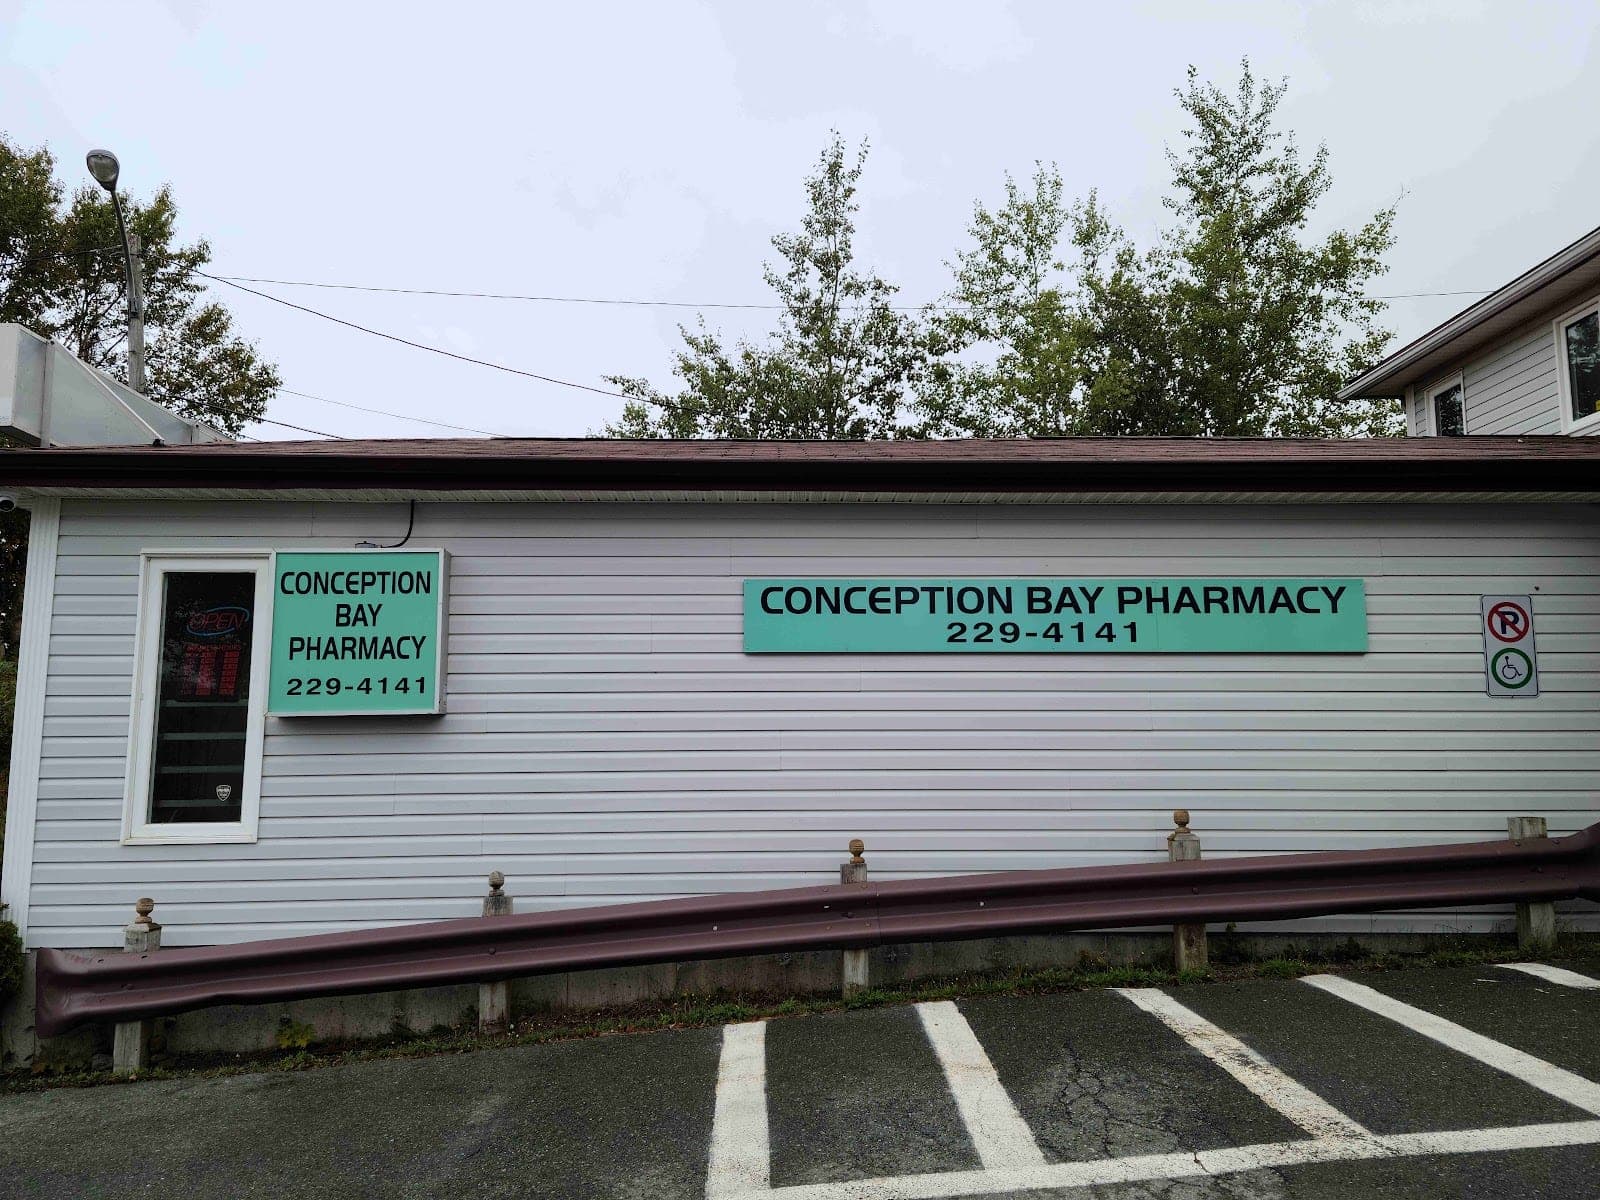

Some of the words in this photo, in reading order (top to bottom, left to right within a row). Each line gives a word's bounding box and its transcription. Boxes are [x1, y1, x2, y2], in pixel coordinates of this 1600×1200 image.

[281, 571, 431, 594] CONCEPTION
[761, 587, 1013, 614] CONCEPTION
[1027, 587, 1105, 614] BAY
[1118, 587, 1347, 614] PHARMACY
[188, 611, 245, 632] OPEN
[336, 604, 382, 627] BAY
[947, 622, 1137, 643] 229-4141
[290, 636, 427, 660] PHARMACY
[287, 677, 425, 696] 229-4141
